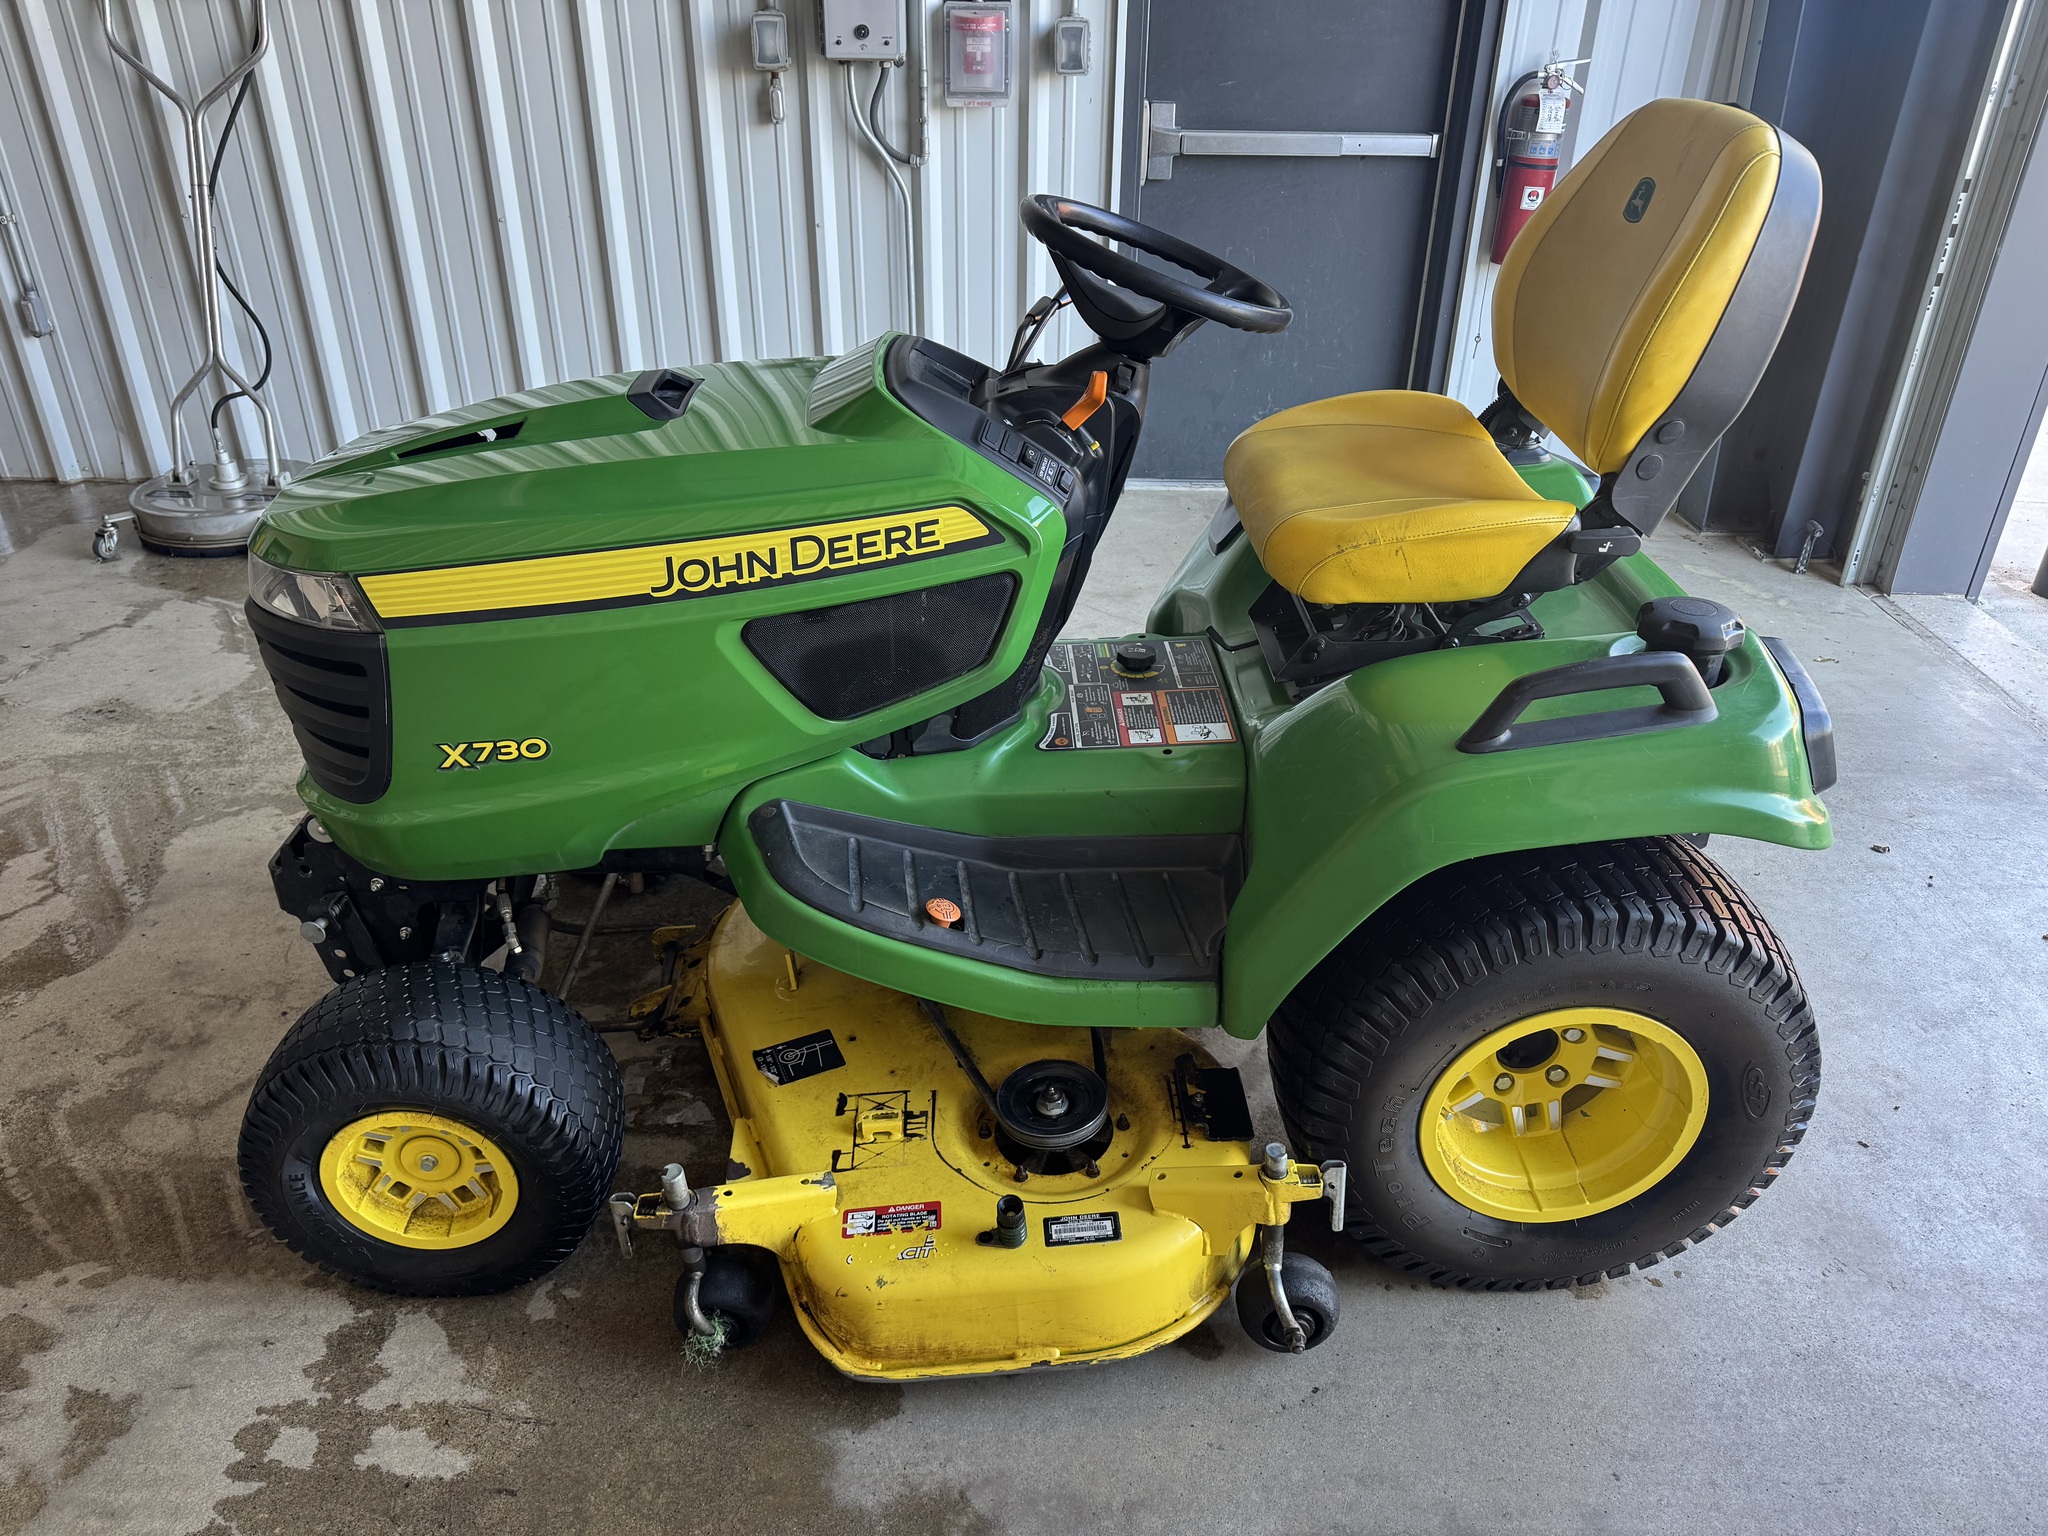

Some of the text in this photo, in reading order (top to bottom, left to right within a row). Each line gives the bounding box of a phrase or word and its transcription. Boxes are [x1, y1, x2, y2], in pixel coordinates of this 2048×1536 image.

[650, 518, 941, 594] JOHN DEERE
[438, 737, 549, 769] X730
[881, 1212, 909, 1220] ROTATING
[895, 1204, 925, 1212] DANGER
